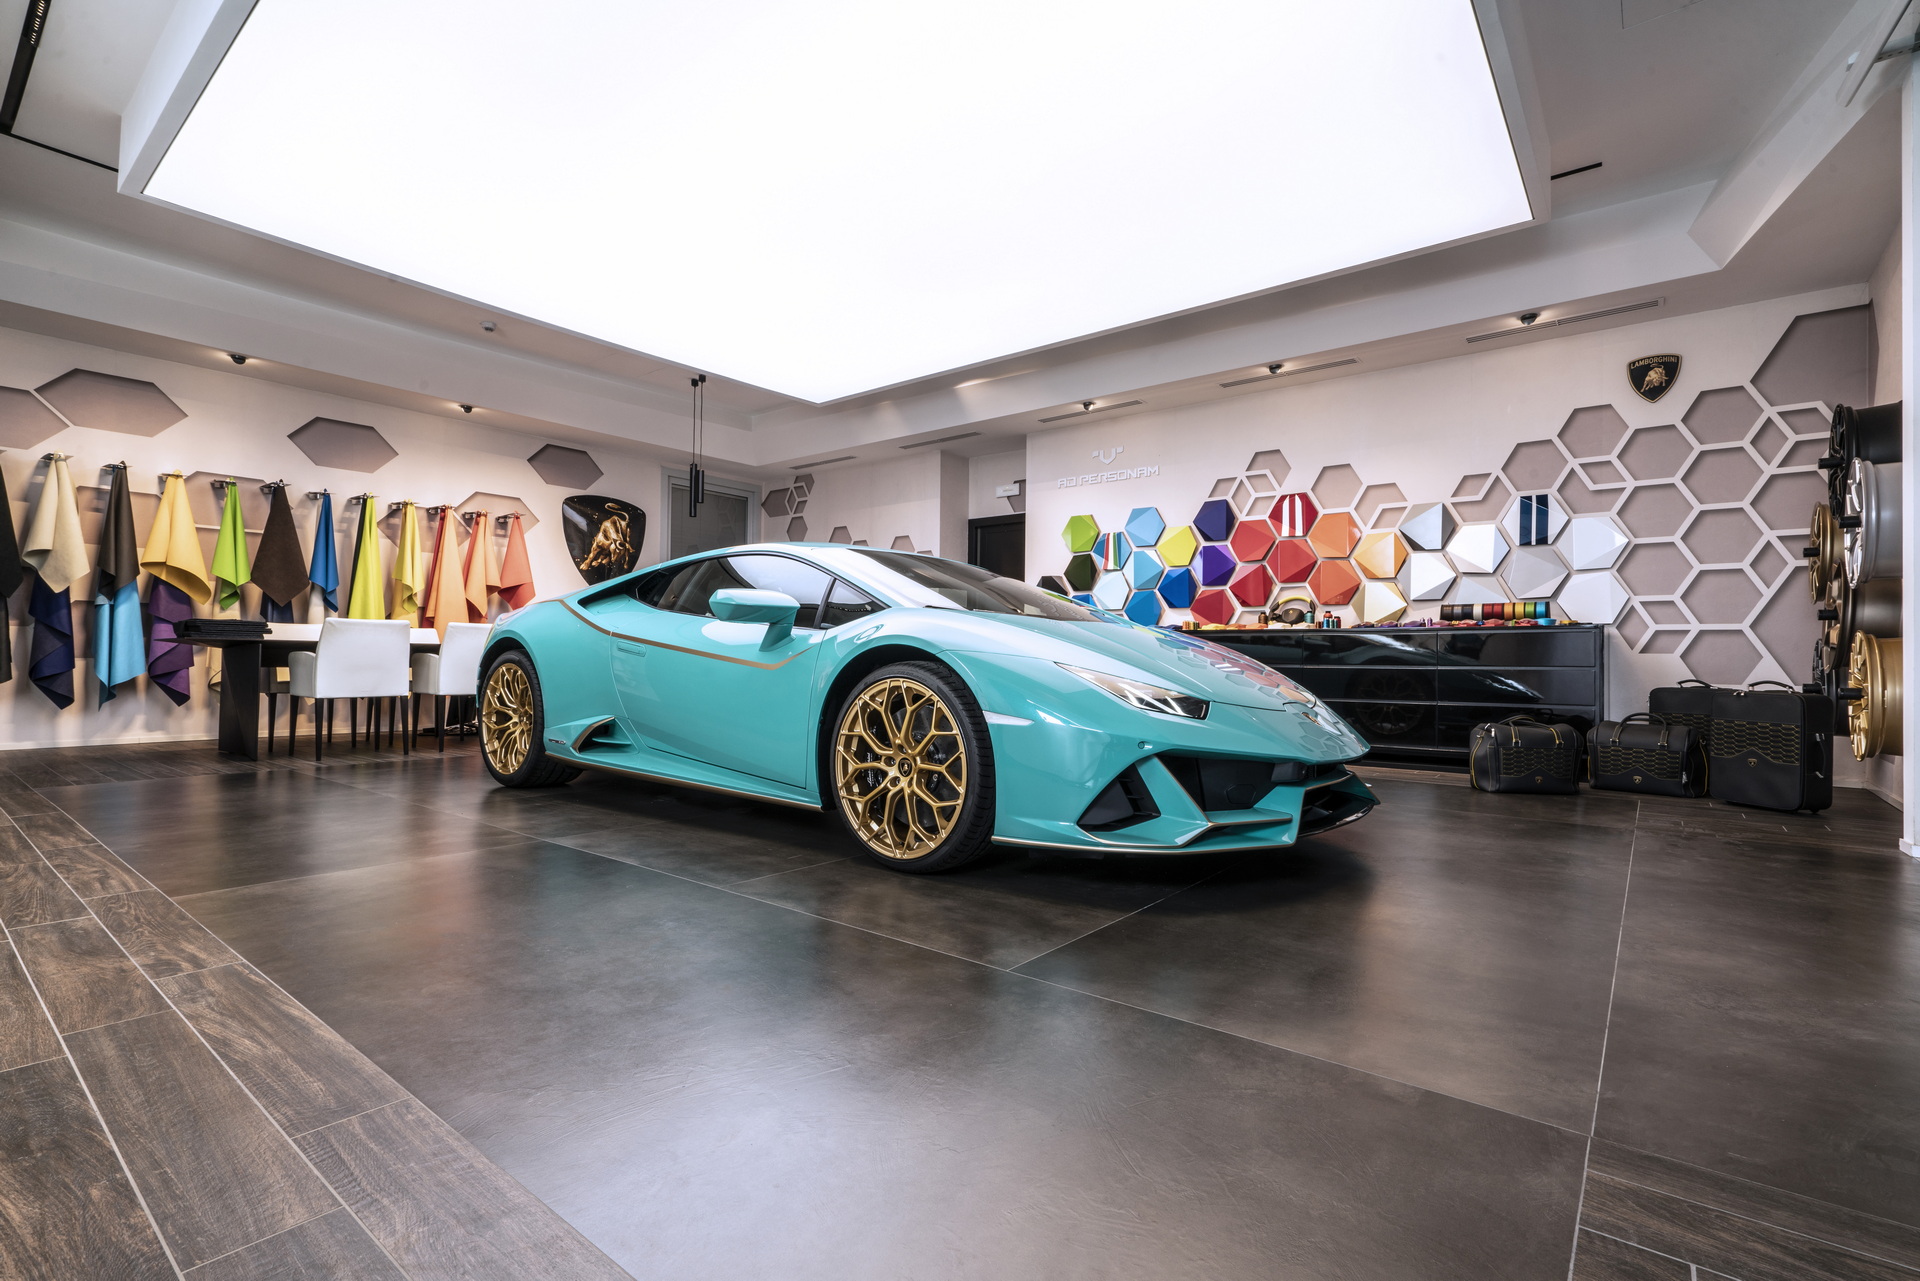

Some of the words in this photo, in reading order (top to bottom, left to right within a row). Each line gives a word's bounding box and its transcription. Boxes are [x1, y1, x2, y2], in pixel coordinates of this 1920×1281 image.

[1630, 356, 1677, 369] LAMBORGHINI
[1057, 477, 1077, 489] AD
[1079, 465, 1160, 486] PERSONAM
